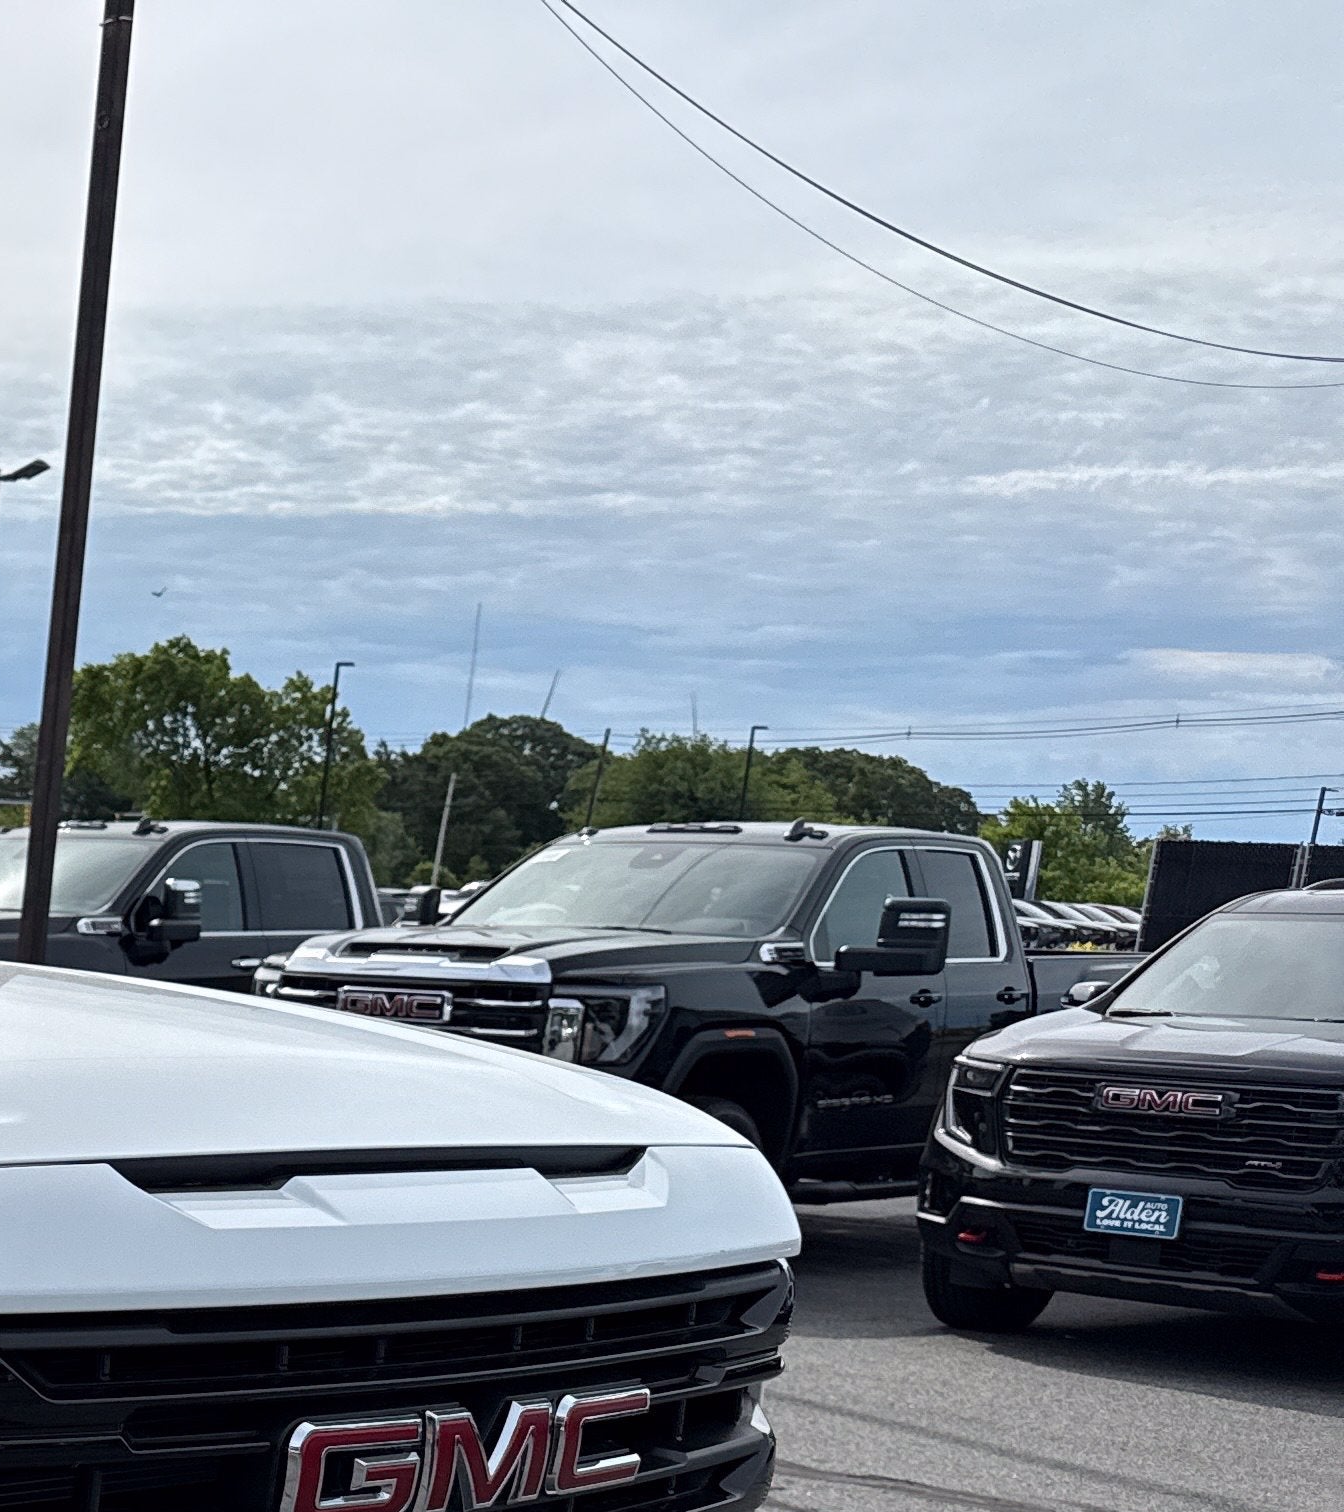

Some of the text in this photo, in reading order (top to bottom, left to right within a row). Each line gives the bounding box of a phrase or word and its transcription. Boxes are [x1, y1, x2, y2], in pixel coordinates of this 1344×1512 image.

[344, 993, 442, 1018] GMC
[1102, 1086, 1223, 1115] GMC
[1095, 1196, 1169, 1223] Alden
[1144, 1202, 1168, 1211] AUTO
[1095, 1217, 1122, 1228] LOVE
[1134, 1222, 1167, 1232] LOCAL
